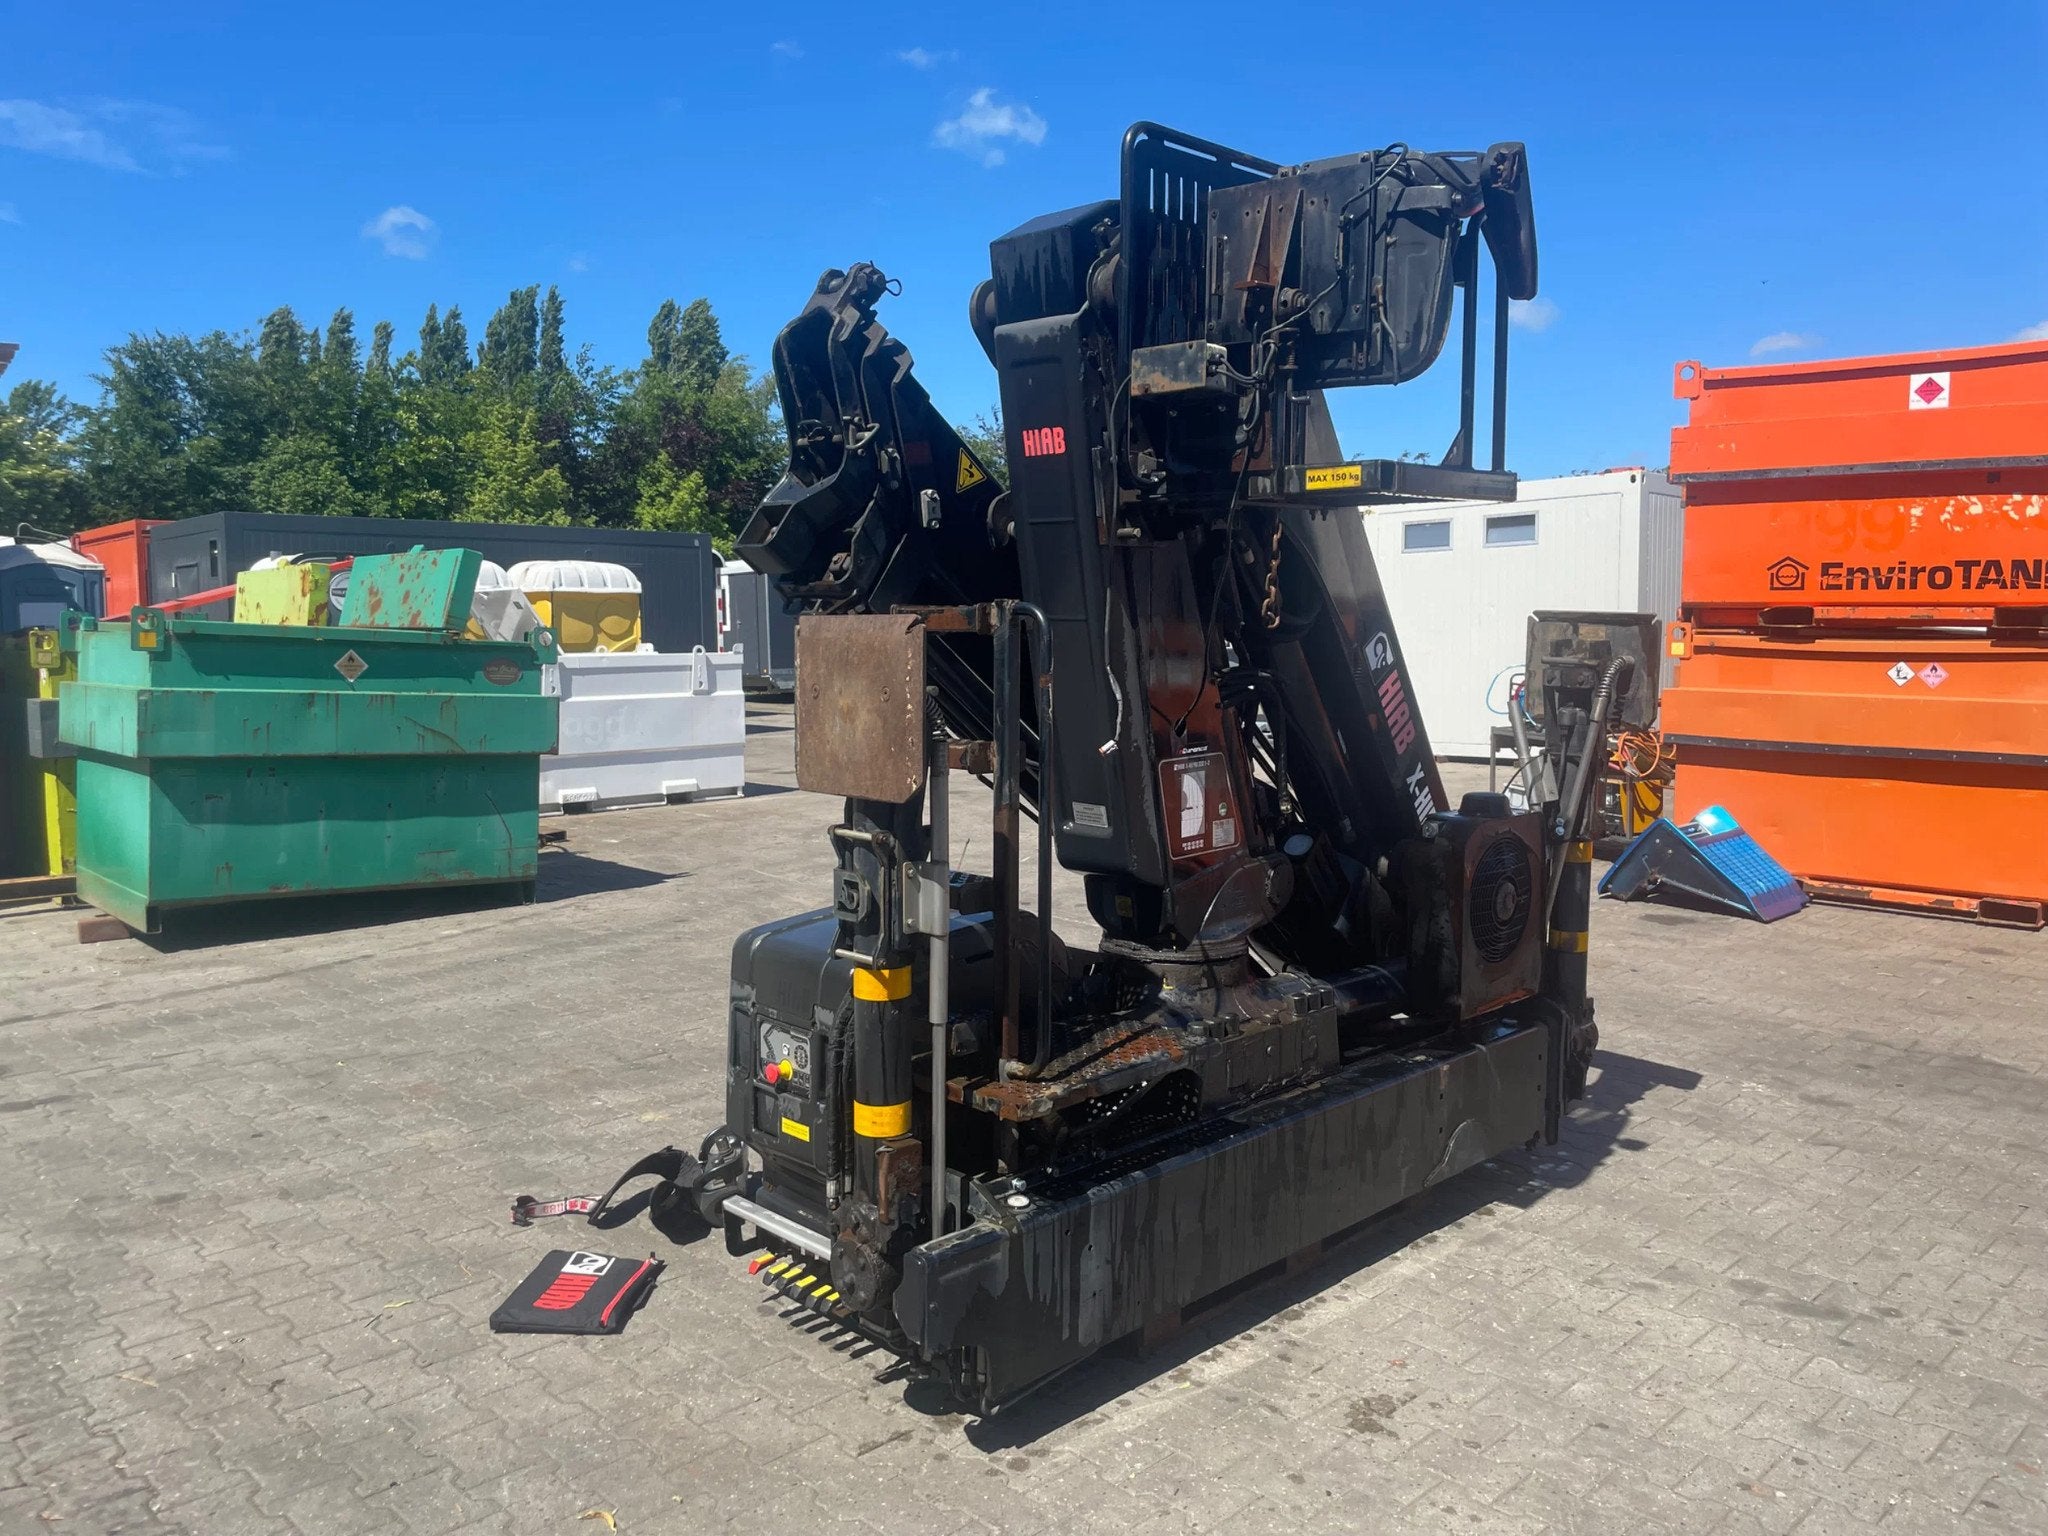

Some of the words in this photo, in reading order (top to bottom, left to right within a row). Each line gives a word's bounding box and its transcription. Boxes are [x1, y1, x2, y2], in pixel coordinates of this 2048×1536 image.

[1022, 426, 1066, 457] HIAB
[1308, 474, 1328, 483] MAX
[1331, 472, 1347, 482] 150
[1349, 472, 1360, 482] kg
[1378, 669, 1416, 754] HIAB
[532, 1273, 599, 1310] HIAB
